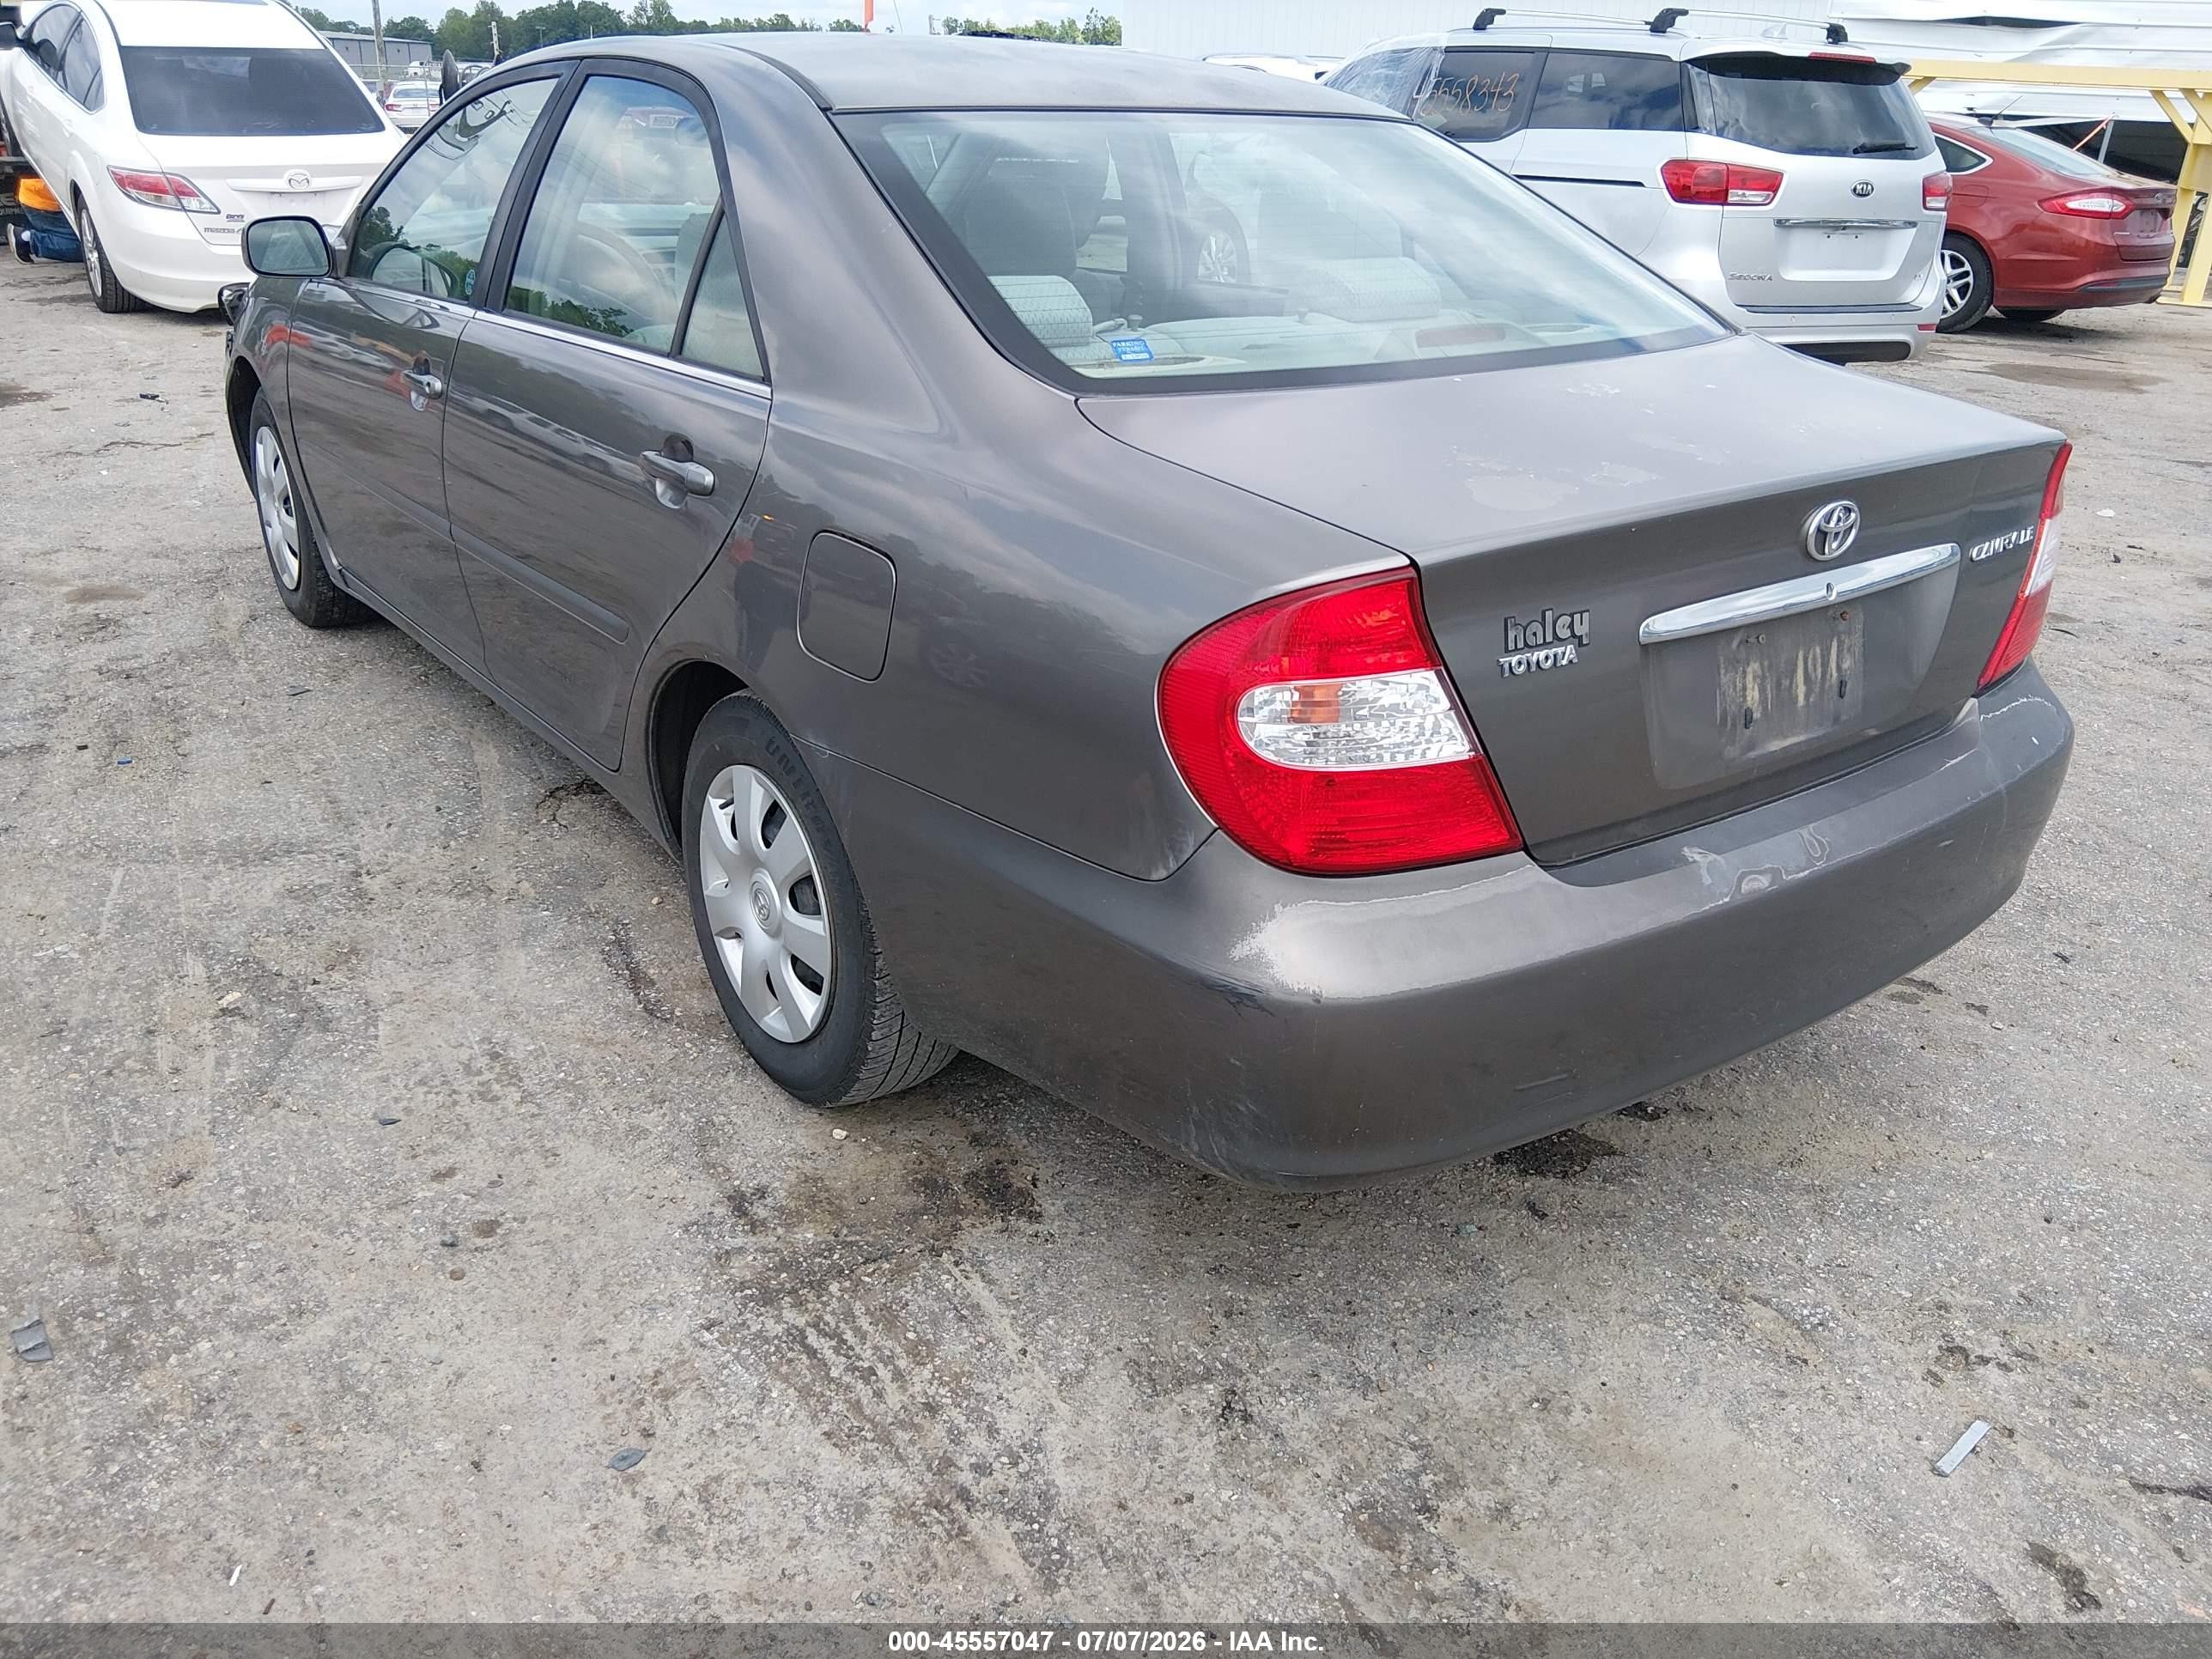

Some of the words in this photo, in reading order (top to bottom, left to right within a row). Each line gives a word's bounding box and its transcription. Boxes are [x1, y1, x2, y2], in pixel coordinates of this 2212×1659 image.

[1855, 183, 1873, 195] KIA
[1504, 608, 1589, 653] haley
[1497, 644, 1578, 678] TOYOTA
